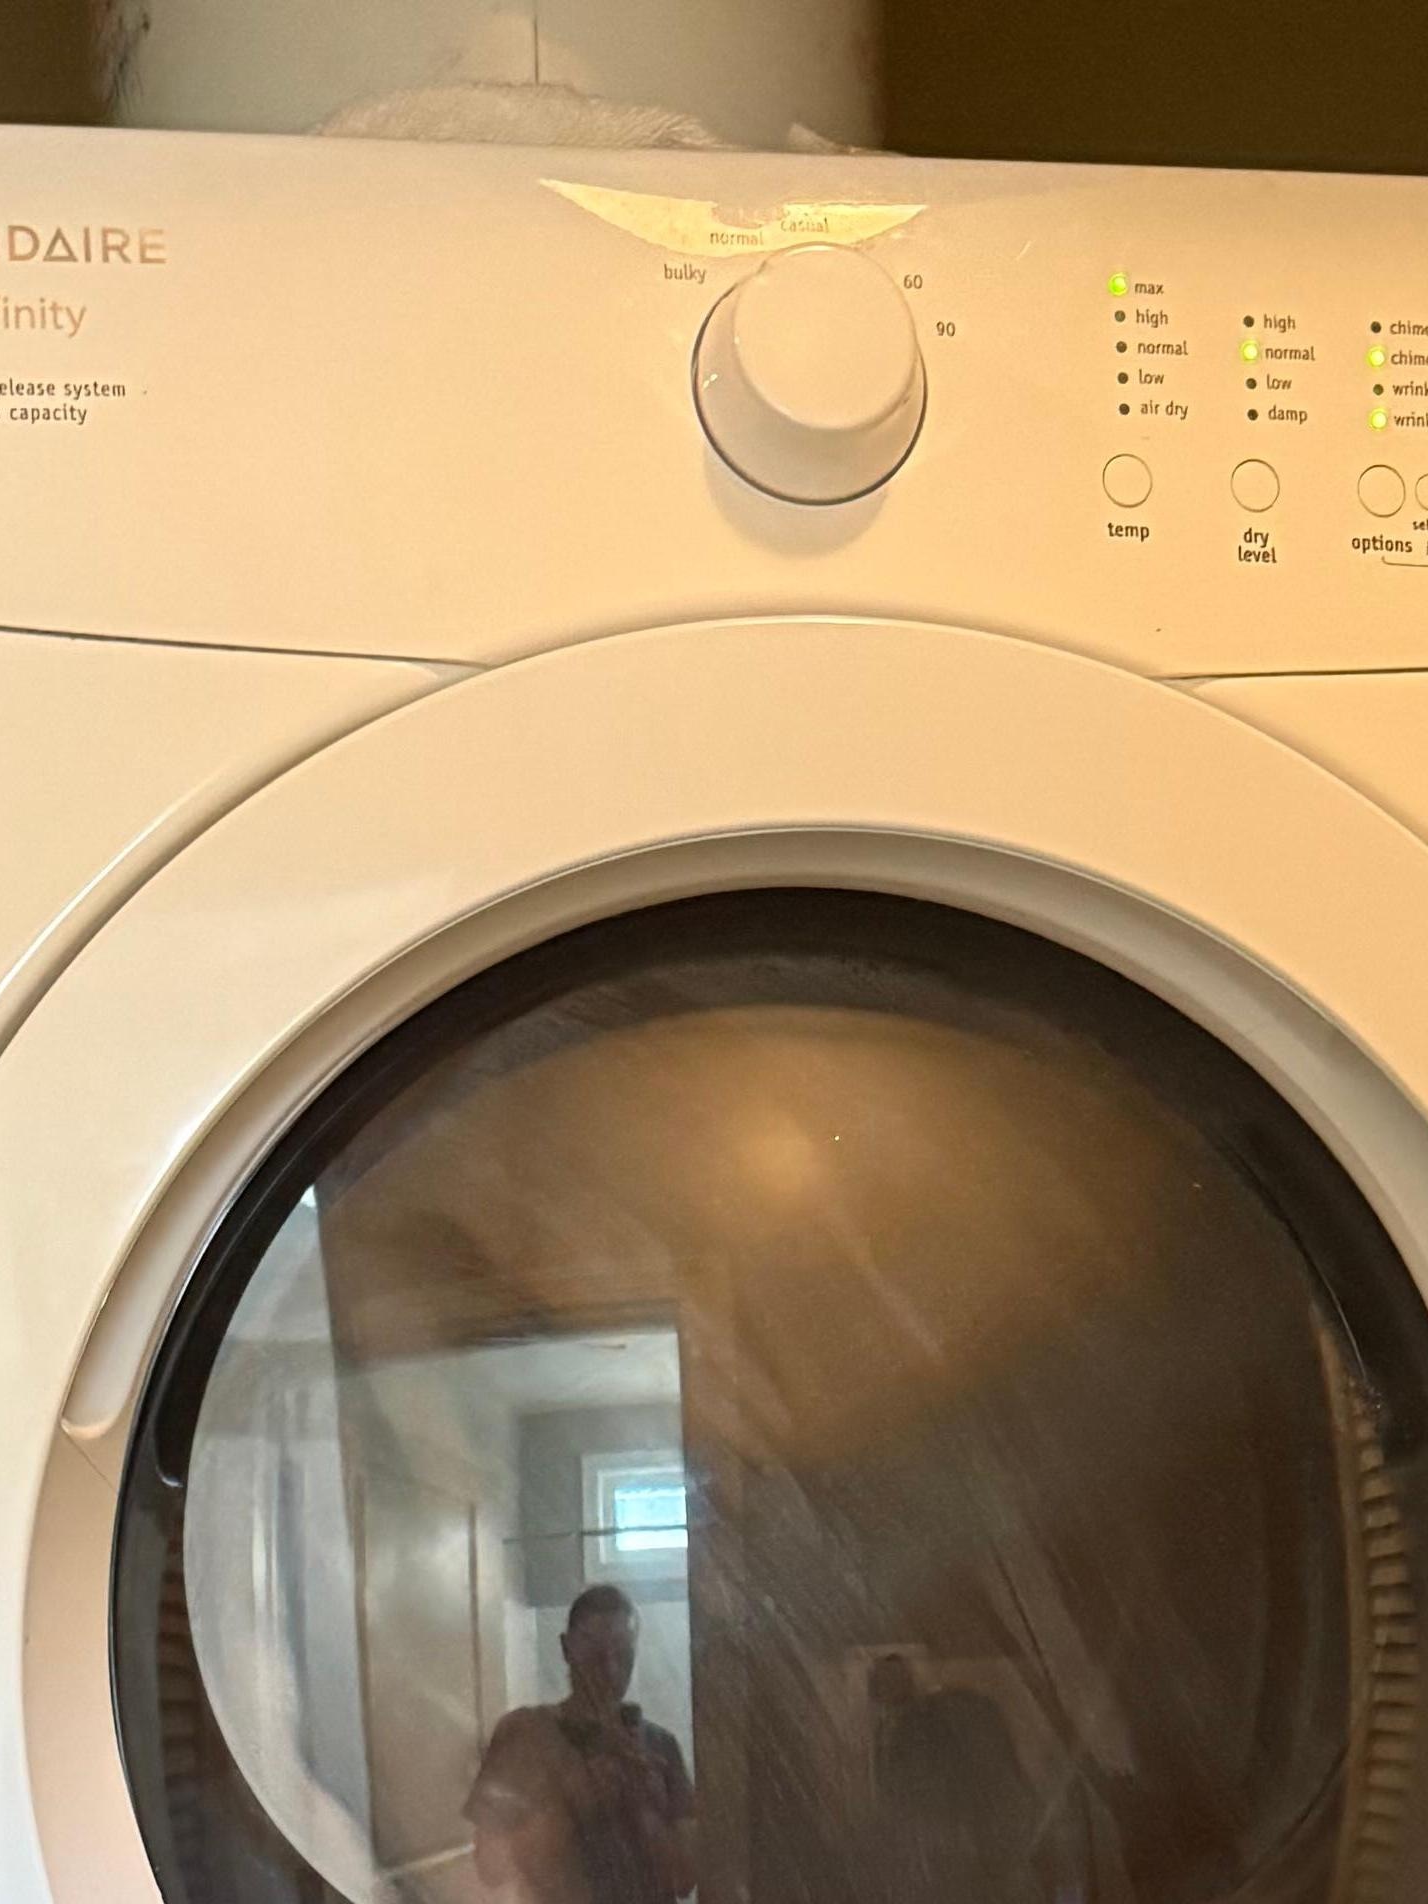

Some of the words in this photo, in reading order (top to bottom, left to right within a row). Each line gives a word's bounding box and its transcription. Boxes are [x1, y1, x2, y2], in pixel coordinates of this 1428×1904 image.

[710, 230, 764, 246] normal
[664, 263, 707, 283] bulky
[903, 275, 923, 290] 60
[1134, 281, 1164, 295] max
[1135, 309, 1169, 327] high
[1263, 314, 1297, 333] high
[935, 321, 956, 337] 90
[1137, 340, 1188, 356] normal
[1265, 346, 1315, 361] normal
[1139, 369, 1164, 385] low
[1266, 374, 1292, 390] low
[64, 380, 127, 399] system
[10, 404, 88, 426] capacity
[1140, 400, 1160, 415] air
[1165, 400, 1189, 421] dry
[1268, 406, 1308, 425] damp
[1107, 522, 1150, 542] temp
[1243, 527, 1269, 548] dry
[1351, 535, 1414, 555] options
[1238, 546, 1277, 564] level
